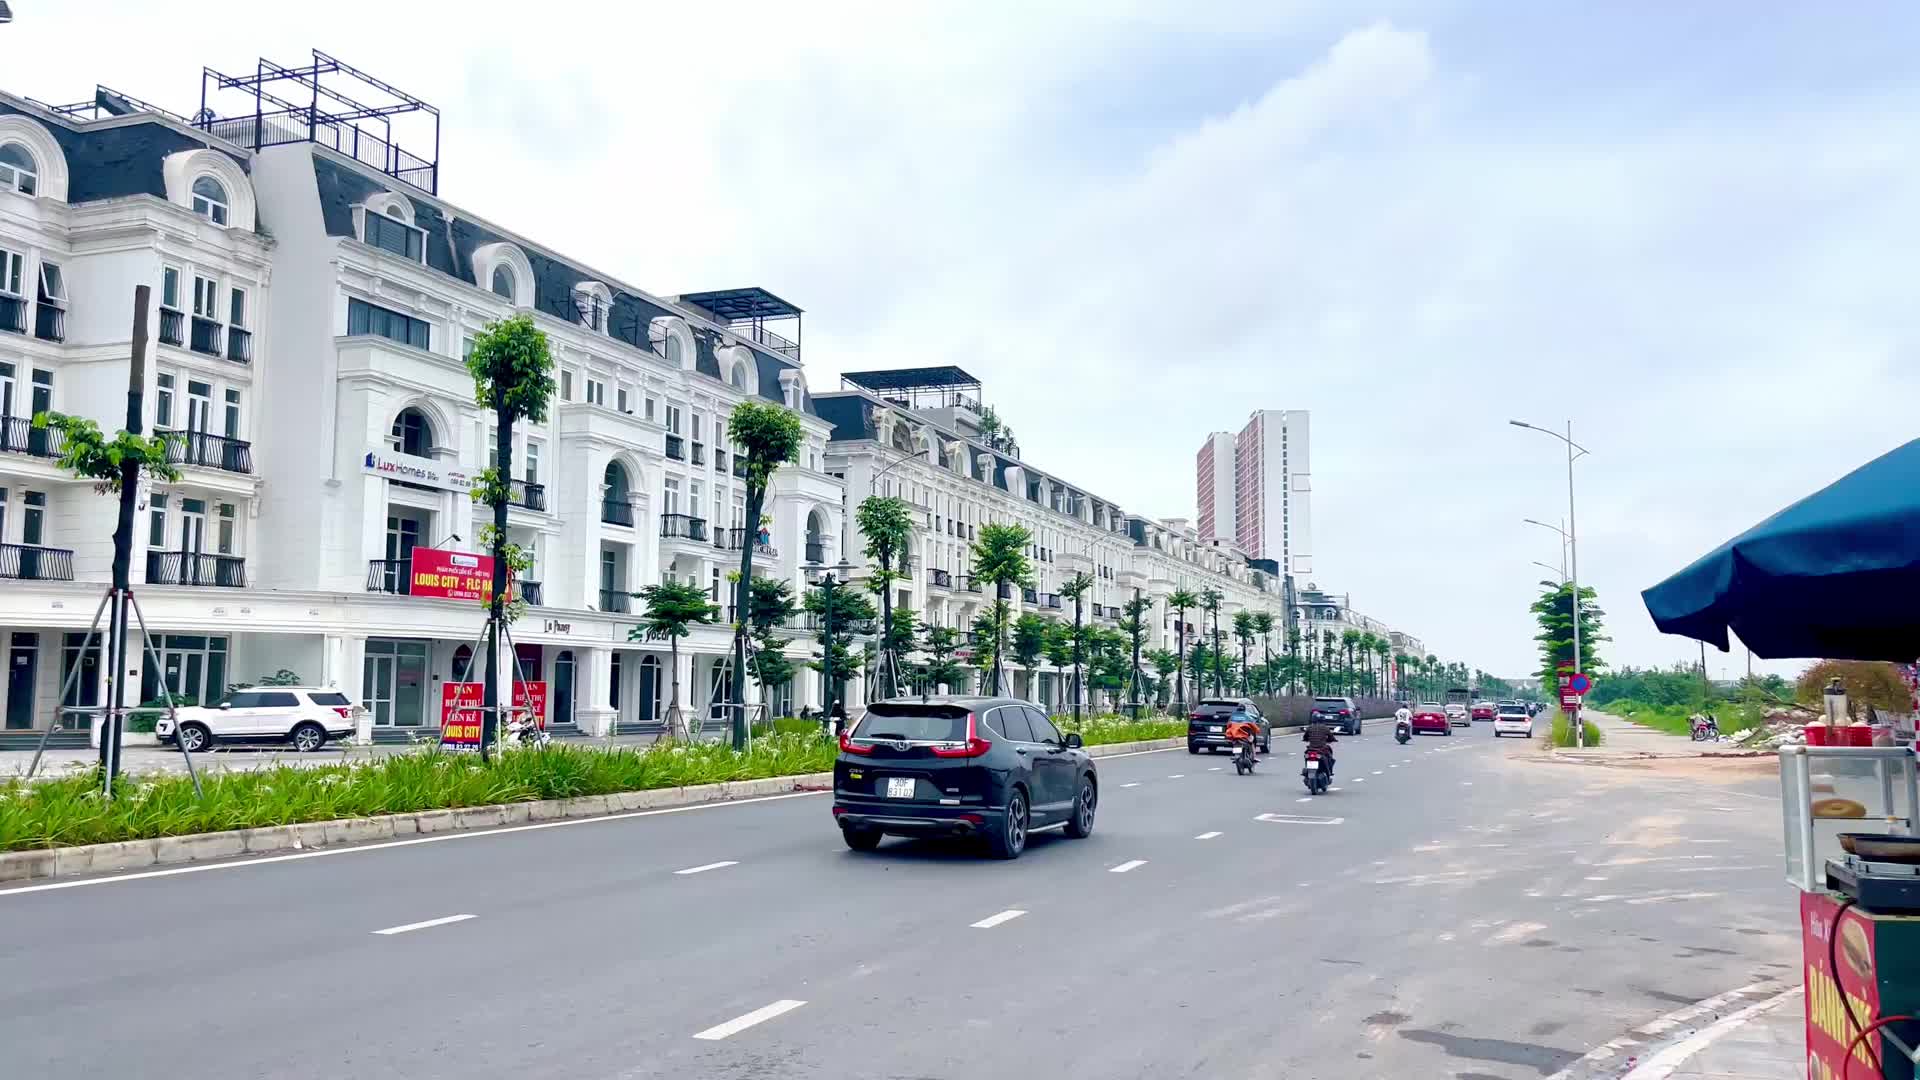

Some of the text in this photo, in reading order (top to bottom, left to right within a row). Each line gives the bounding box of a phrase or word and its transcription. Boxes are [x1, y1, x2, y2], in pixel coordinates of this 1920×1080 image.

[415, 572, 440, 587] LOUIS
[441, 575, 460, 589] CITY
[466, 577, 480, 590] FLC
[445, 698, 464, 707] BIT
[464, 725, 481, 739] CITY
[894, 778, 909, 787] 30F
